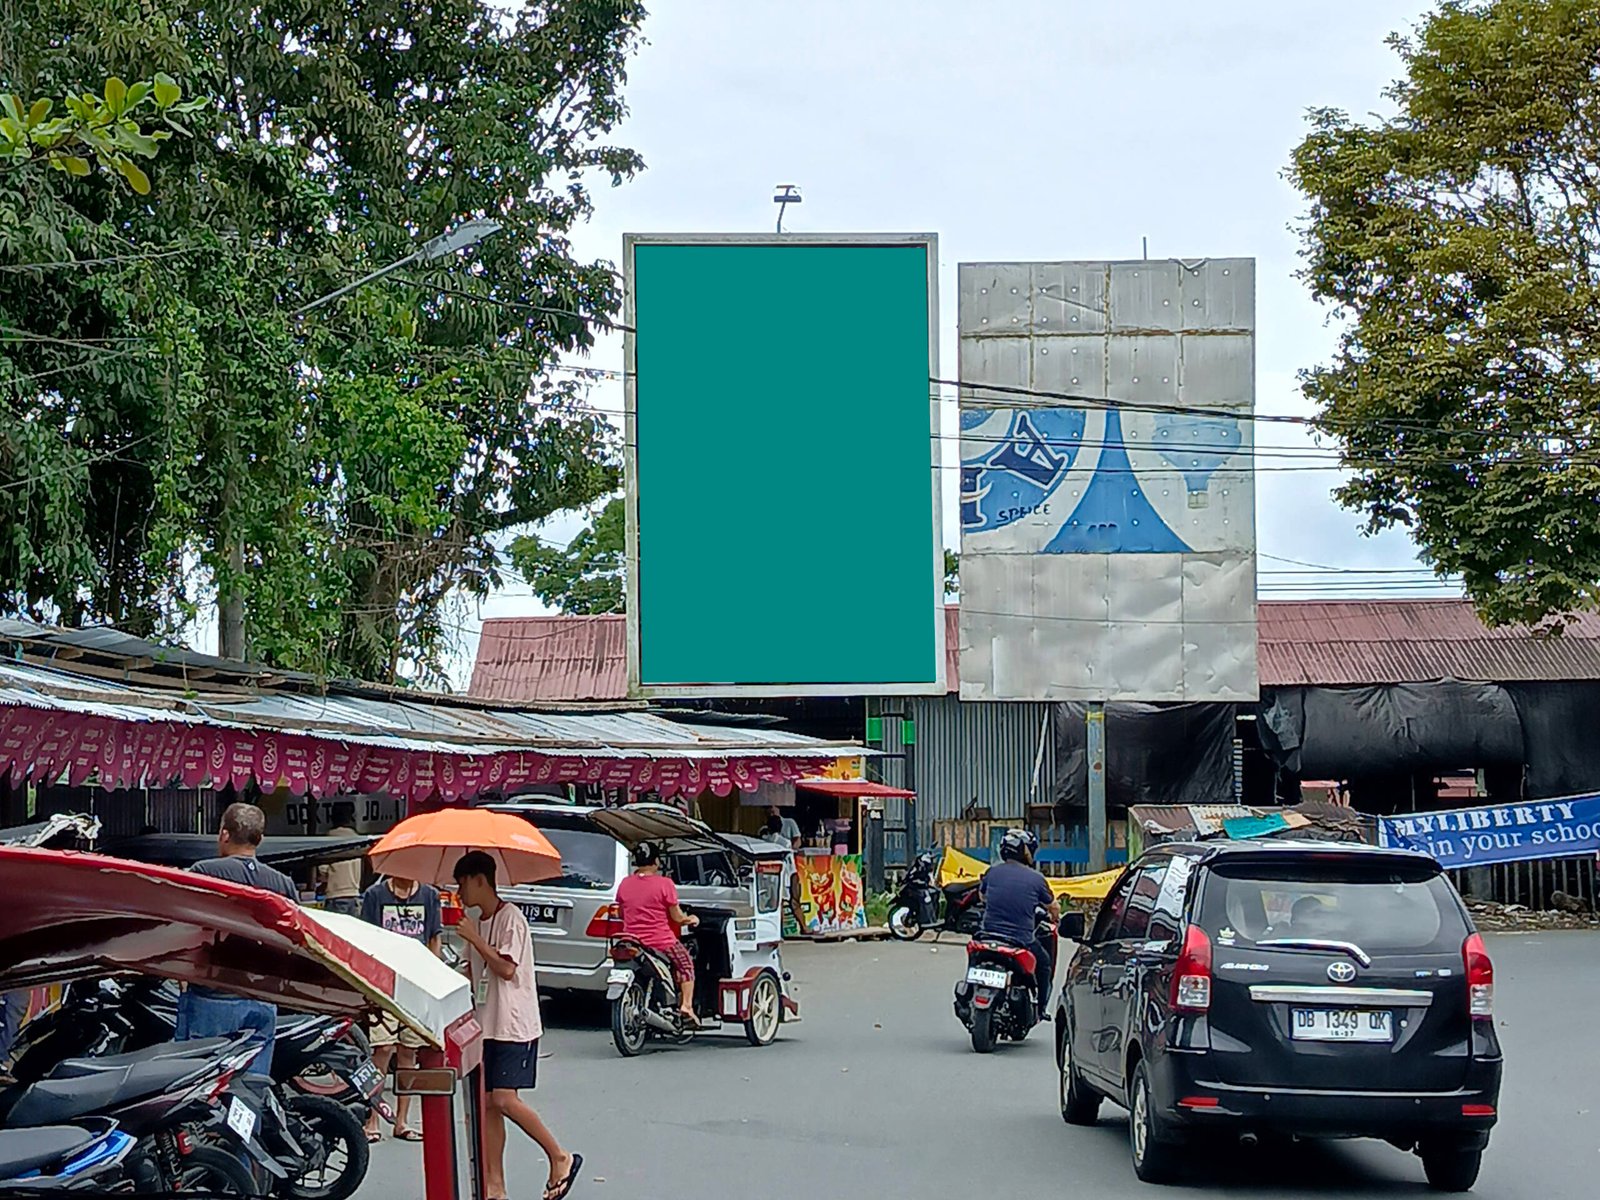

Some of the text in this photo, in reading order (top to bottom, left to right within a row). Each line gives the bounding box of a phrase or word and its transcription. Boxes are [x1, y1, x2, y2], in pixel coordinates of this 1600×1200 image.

[1461, 832, 1522, 859] your
[1297, 1010, 1315, 1028] DB
[1325, 1011, 1359, 1030] 1349
